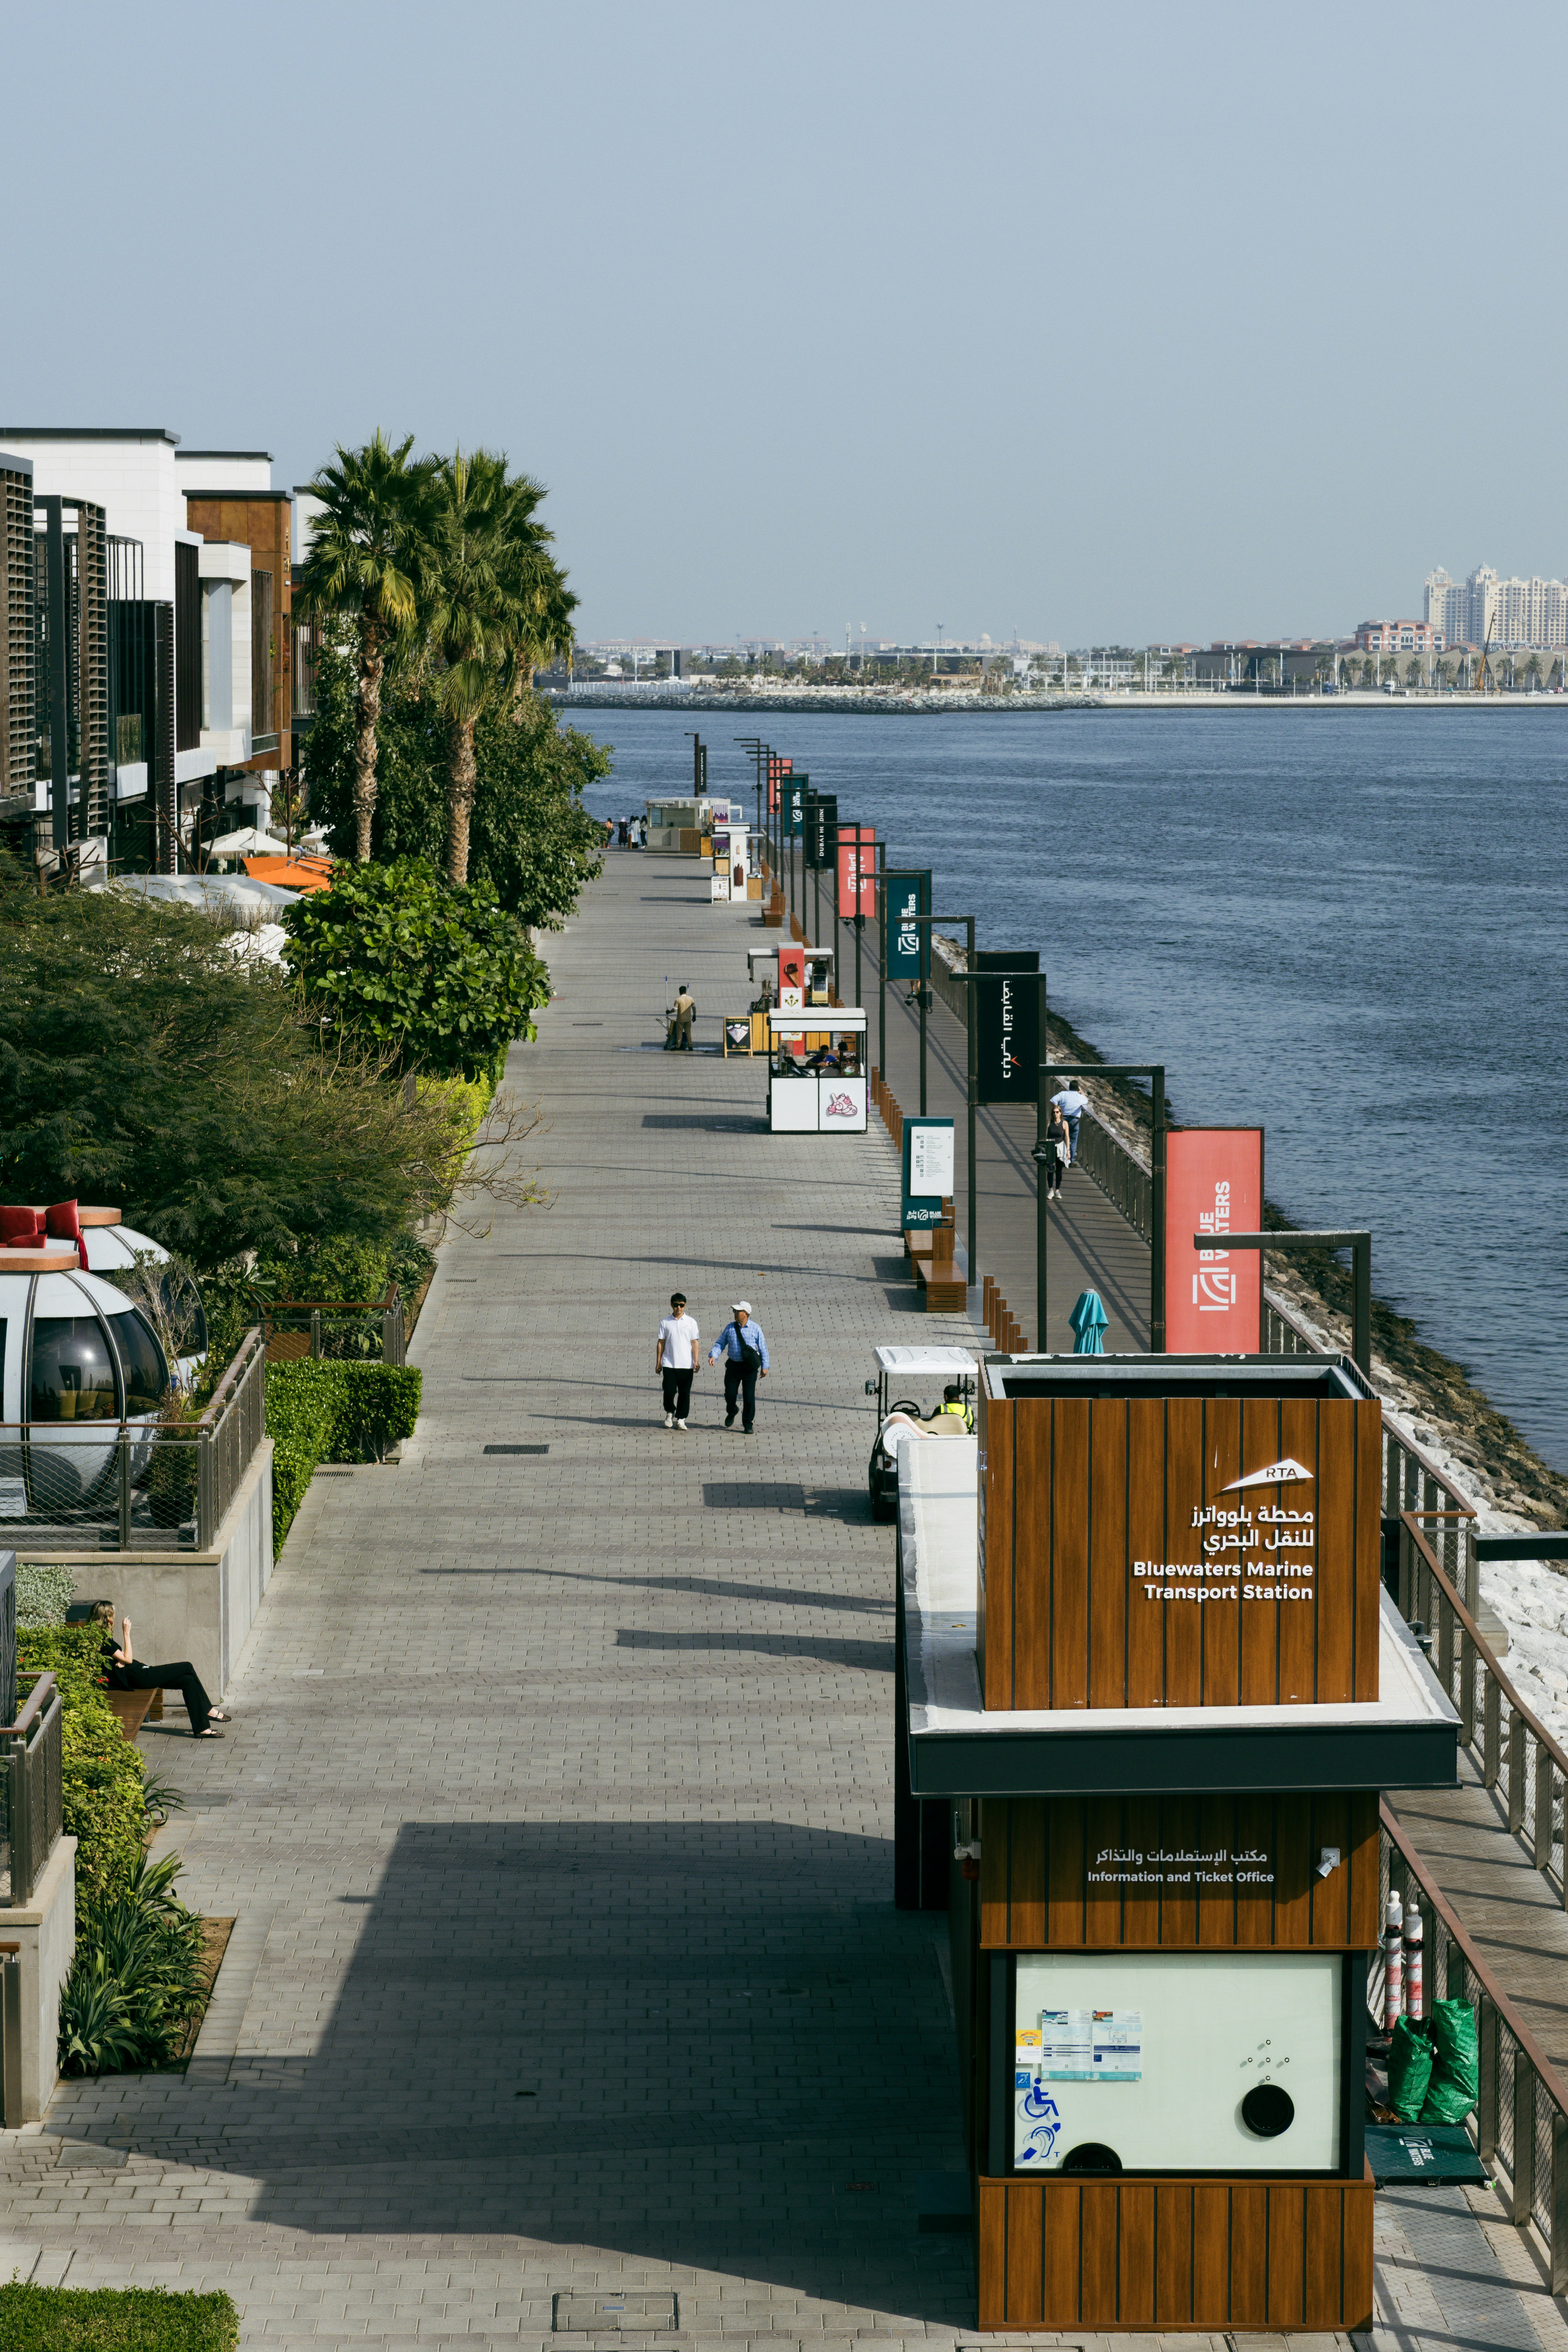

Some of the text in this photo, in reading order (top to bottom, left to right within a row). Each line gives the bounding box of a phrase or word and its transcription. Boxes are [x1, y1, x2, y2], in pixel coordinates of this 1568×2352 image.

[1215, 1181, 1230, 1260] WTERS
[899, 1431, 915, 1439] FILTERE
[1266, 1467, 1299, 1479] RTA
[1191, 1505, 1314, 1528] محطة بلوواترز
[1203, 1529, 1314, 1556] للنقل البحري
[1134, 1561, 1313, 1576] Bluewaters Marine
[1144, 1584, 1312, 1603] Transport Station
[1096, 1849, 1267, 1866] مكتب الإستعلامات والتذاكر
[1088, 1871, 1274, 1882] Information and Ticket Office
[1408, 2148, 1425, 2166] WATERS
[1420, 2148, 1434, 2160] BLUE
